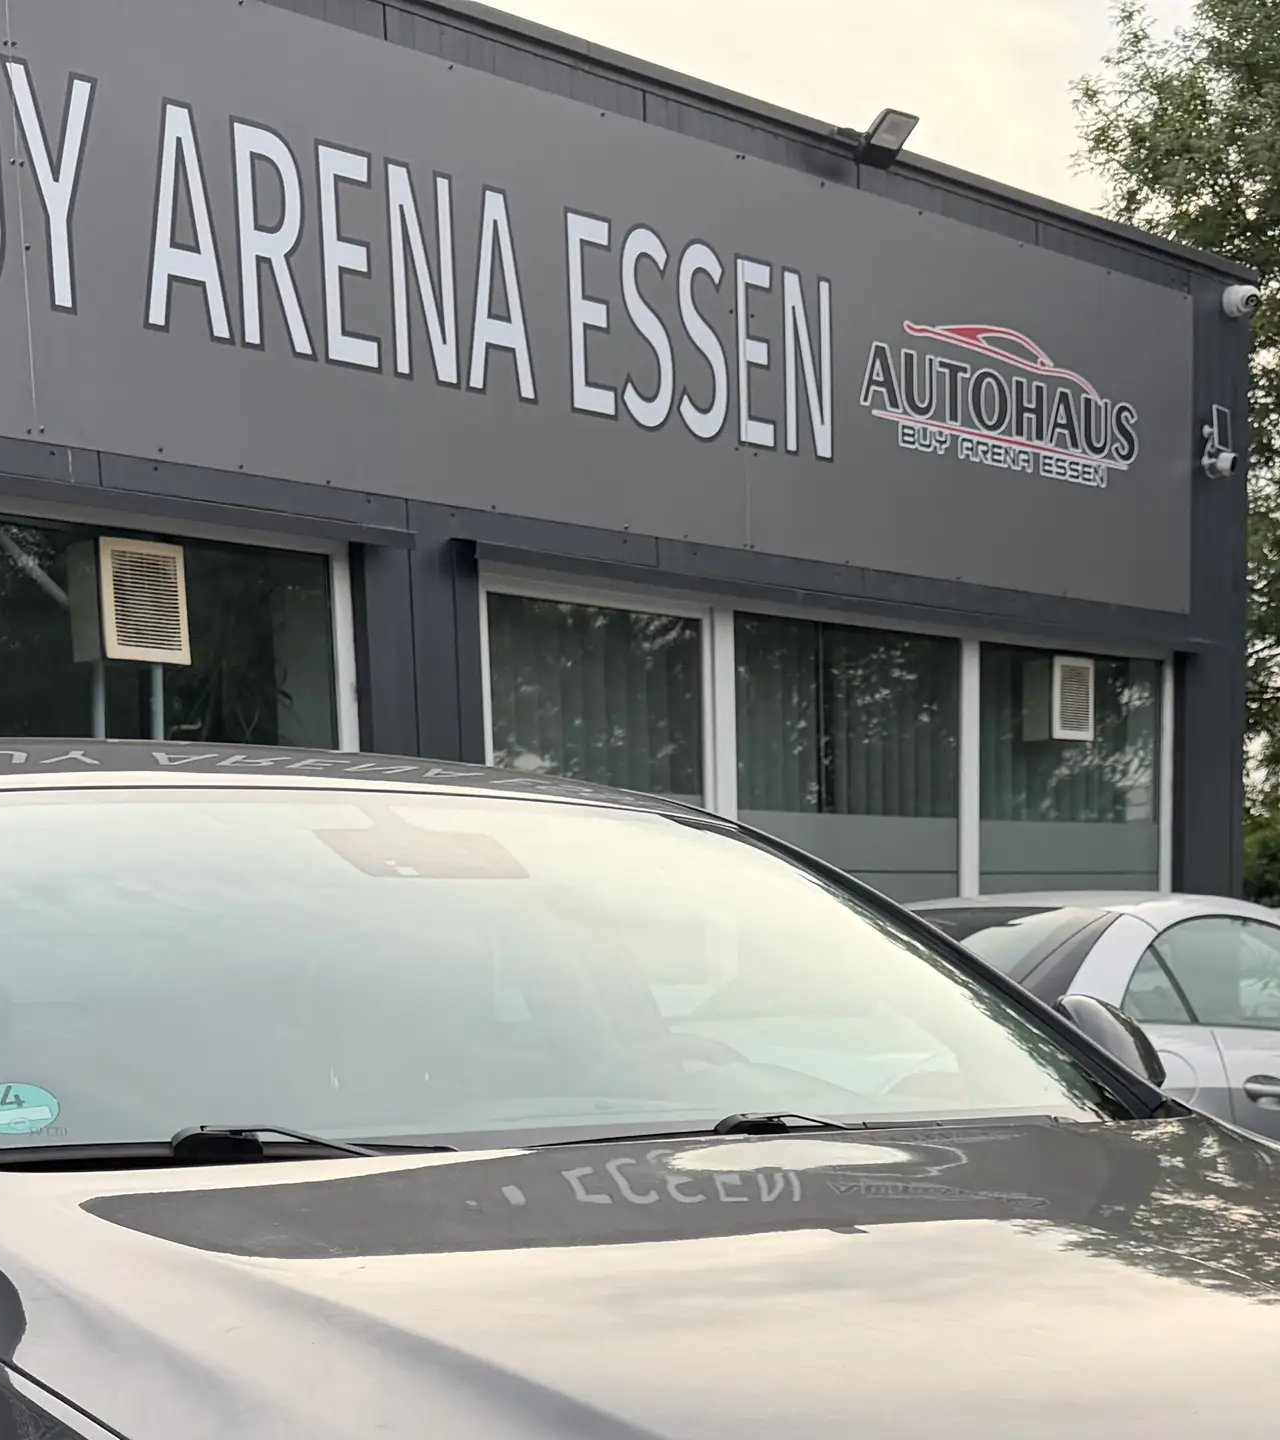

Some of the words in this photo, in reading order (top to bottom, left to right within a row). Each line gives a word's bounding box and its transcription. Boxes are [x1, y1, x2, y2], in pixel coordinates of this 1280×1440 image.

[148, 104, 535, 399] ARENA
[565, 211, 834, 458] ESSEN
[860, 341, 1137, 464] AUTOHAUS
[898, 424, 949, 455] BUY
[958, 438, 1033, 473] ARENA
[1039, 455, 1108, 488] ESSEN
[0, 1085, 25, 1107] 4
